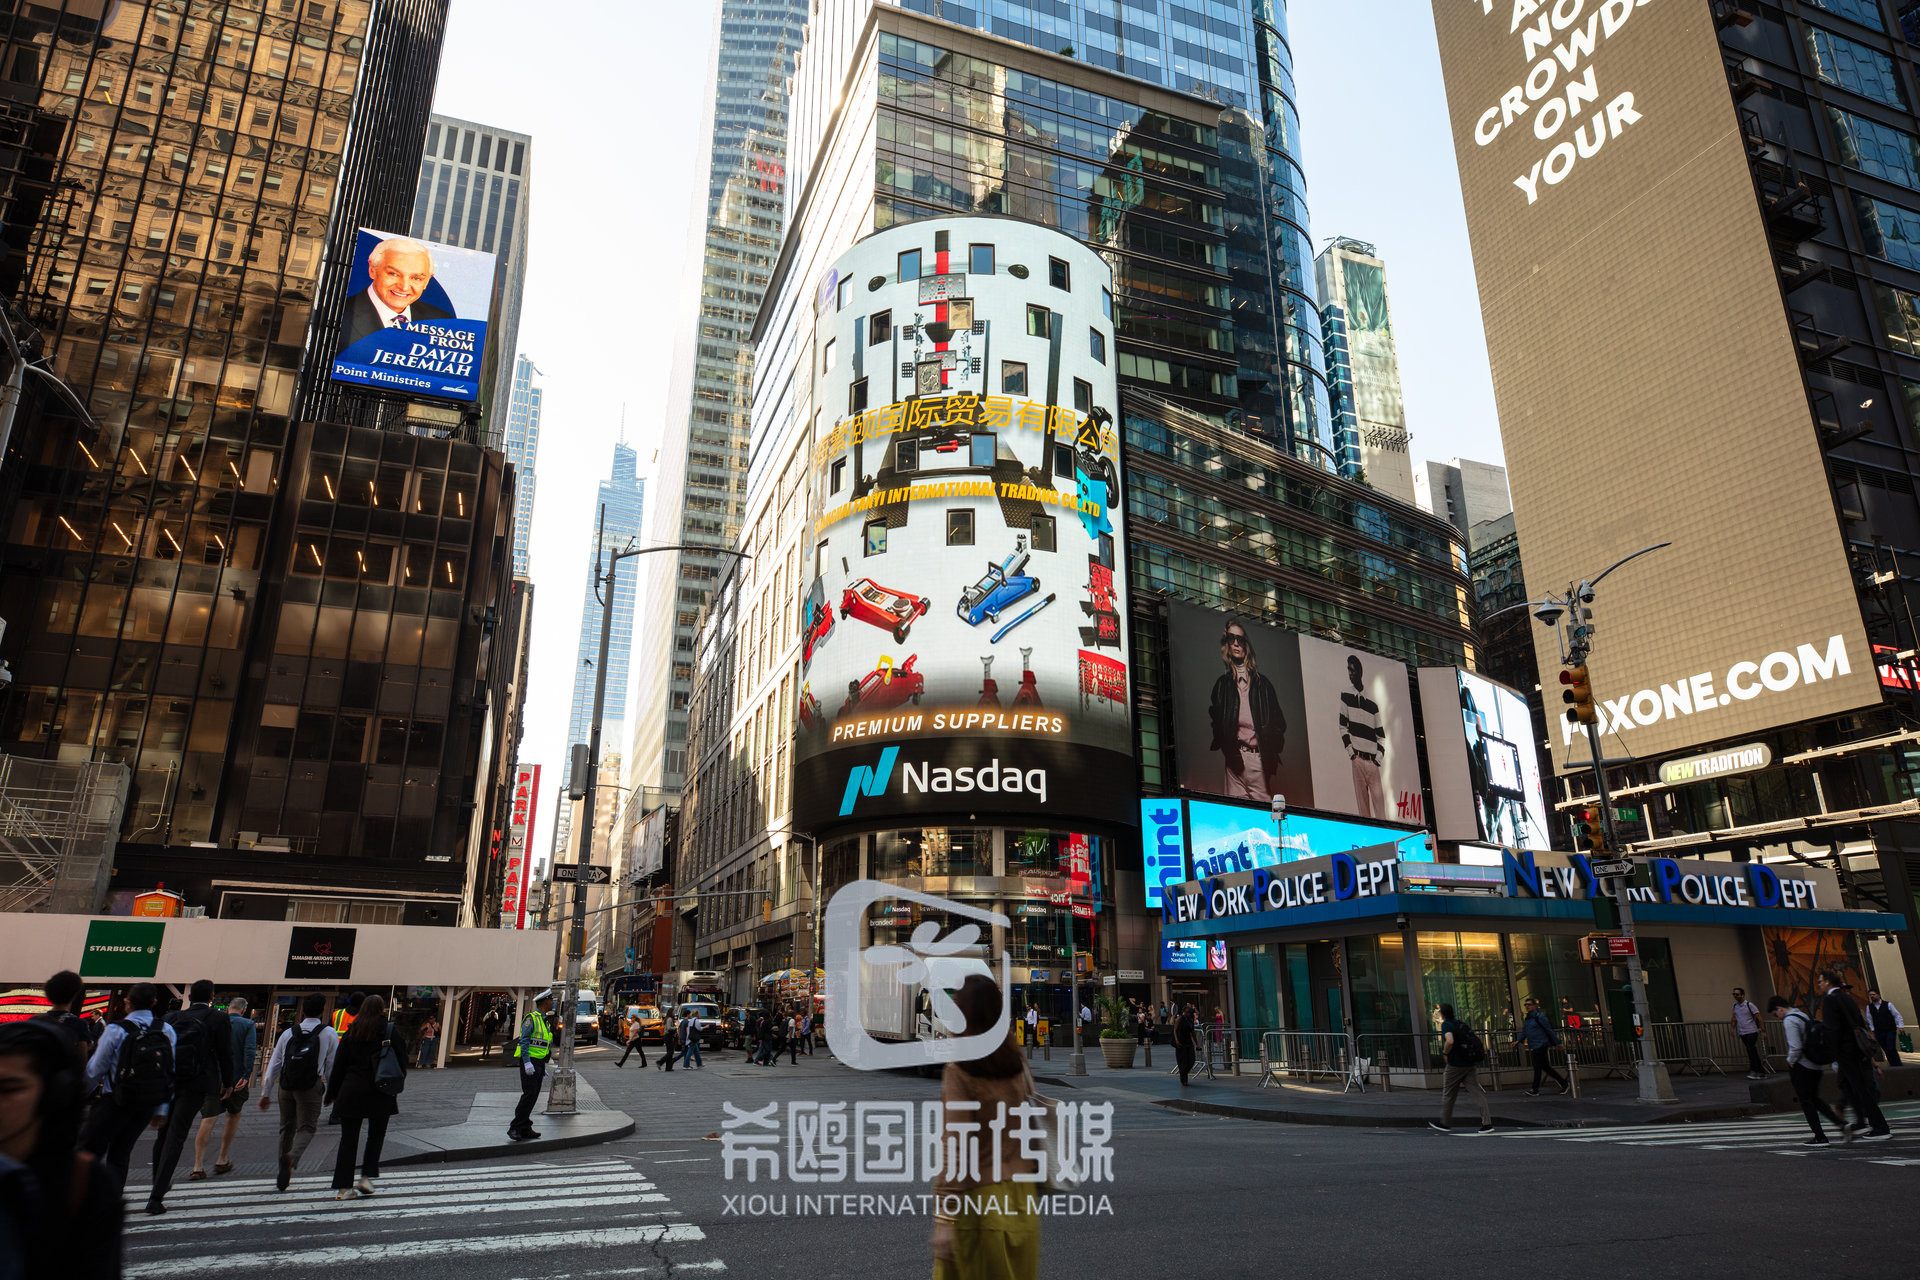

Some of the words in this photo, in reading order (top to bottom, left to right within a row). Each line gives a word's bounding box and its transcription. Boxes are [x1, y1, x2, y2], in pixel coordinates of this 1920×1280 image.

[1474, 0, 1652, 146] CROWD
[1533, 64, 1600, 141] ON
[1513, 91, 1643, 206] YOUR
[391, 319, 402, 330] A
[405, 323, 475, 342] MESSAGE
[430, 335, 474, 351] FROM
[369, 348, 472, 377] JEREMIAH
[409, 344, 473, 364] DAVID
[335, 364, 368, 378] Point
[371, 370, 431, 389] Ministries
[853, 489, 887, 514] FANYI
[887, 480, 997, 505] INTERNATIONAL
[1000, 482, 1059, 506] TRADING
[832, 714, 923, 742] PREMIUM
[933, 712, 1063, 734] SUPPLIERS
[902, 758, 1047, 804] Nasdaq
[513, 772, 530, 825] PARK
[1397, 790, 1422, 824] H&M
[562, 869, 577, 877] ONE
[1193, 841, 1253, 881] hint
[1596, 865, 1608, 873] ONE
[1615, 863, 1628, 872] WAY
[503, 857, 521, 913] PARK
[891, 905, 911, 913] Nasdaq
[1026, 906, 1047, 914] Nasdaq
[89, 945, 142, 953] STARBUCKS
